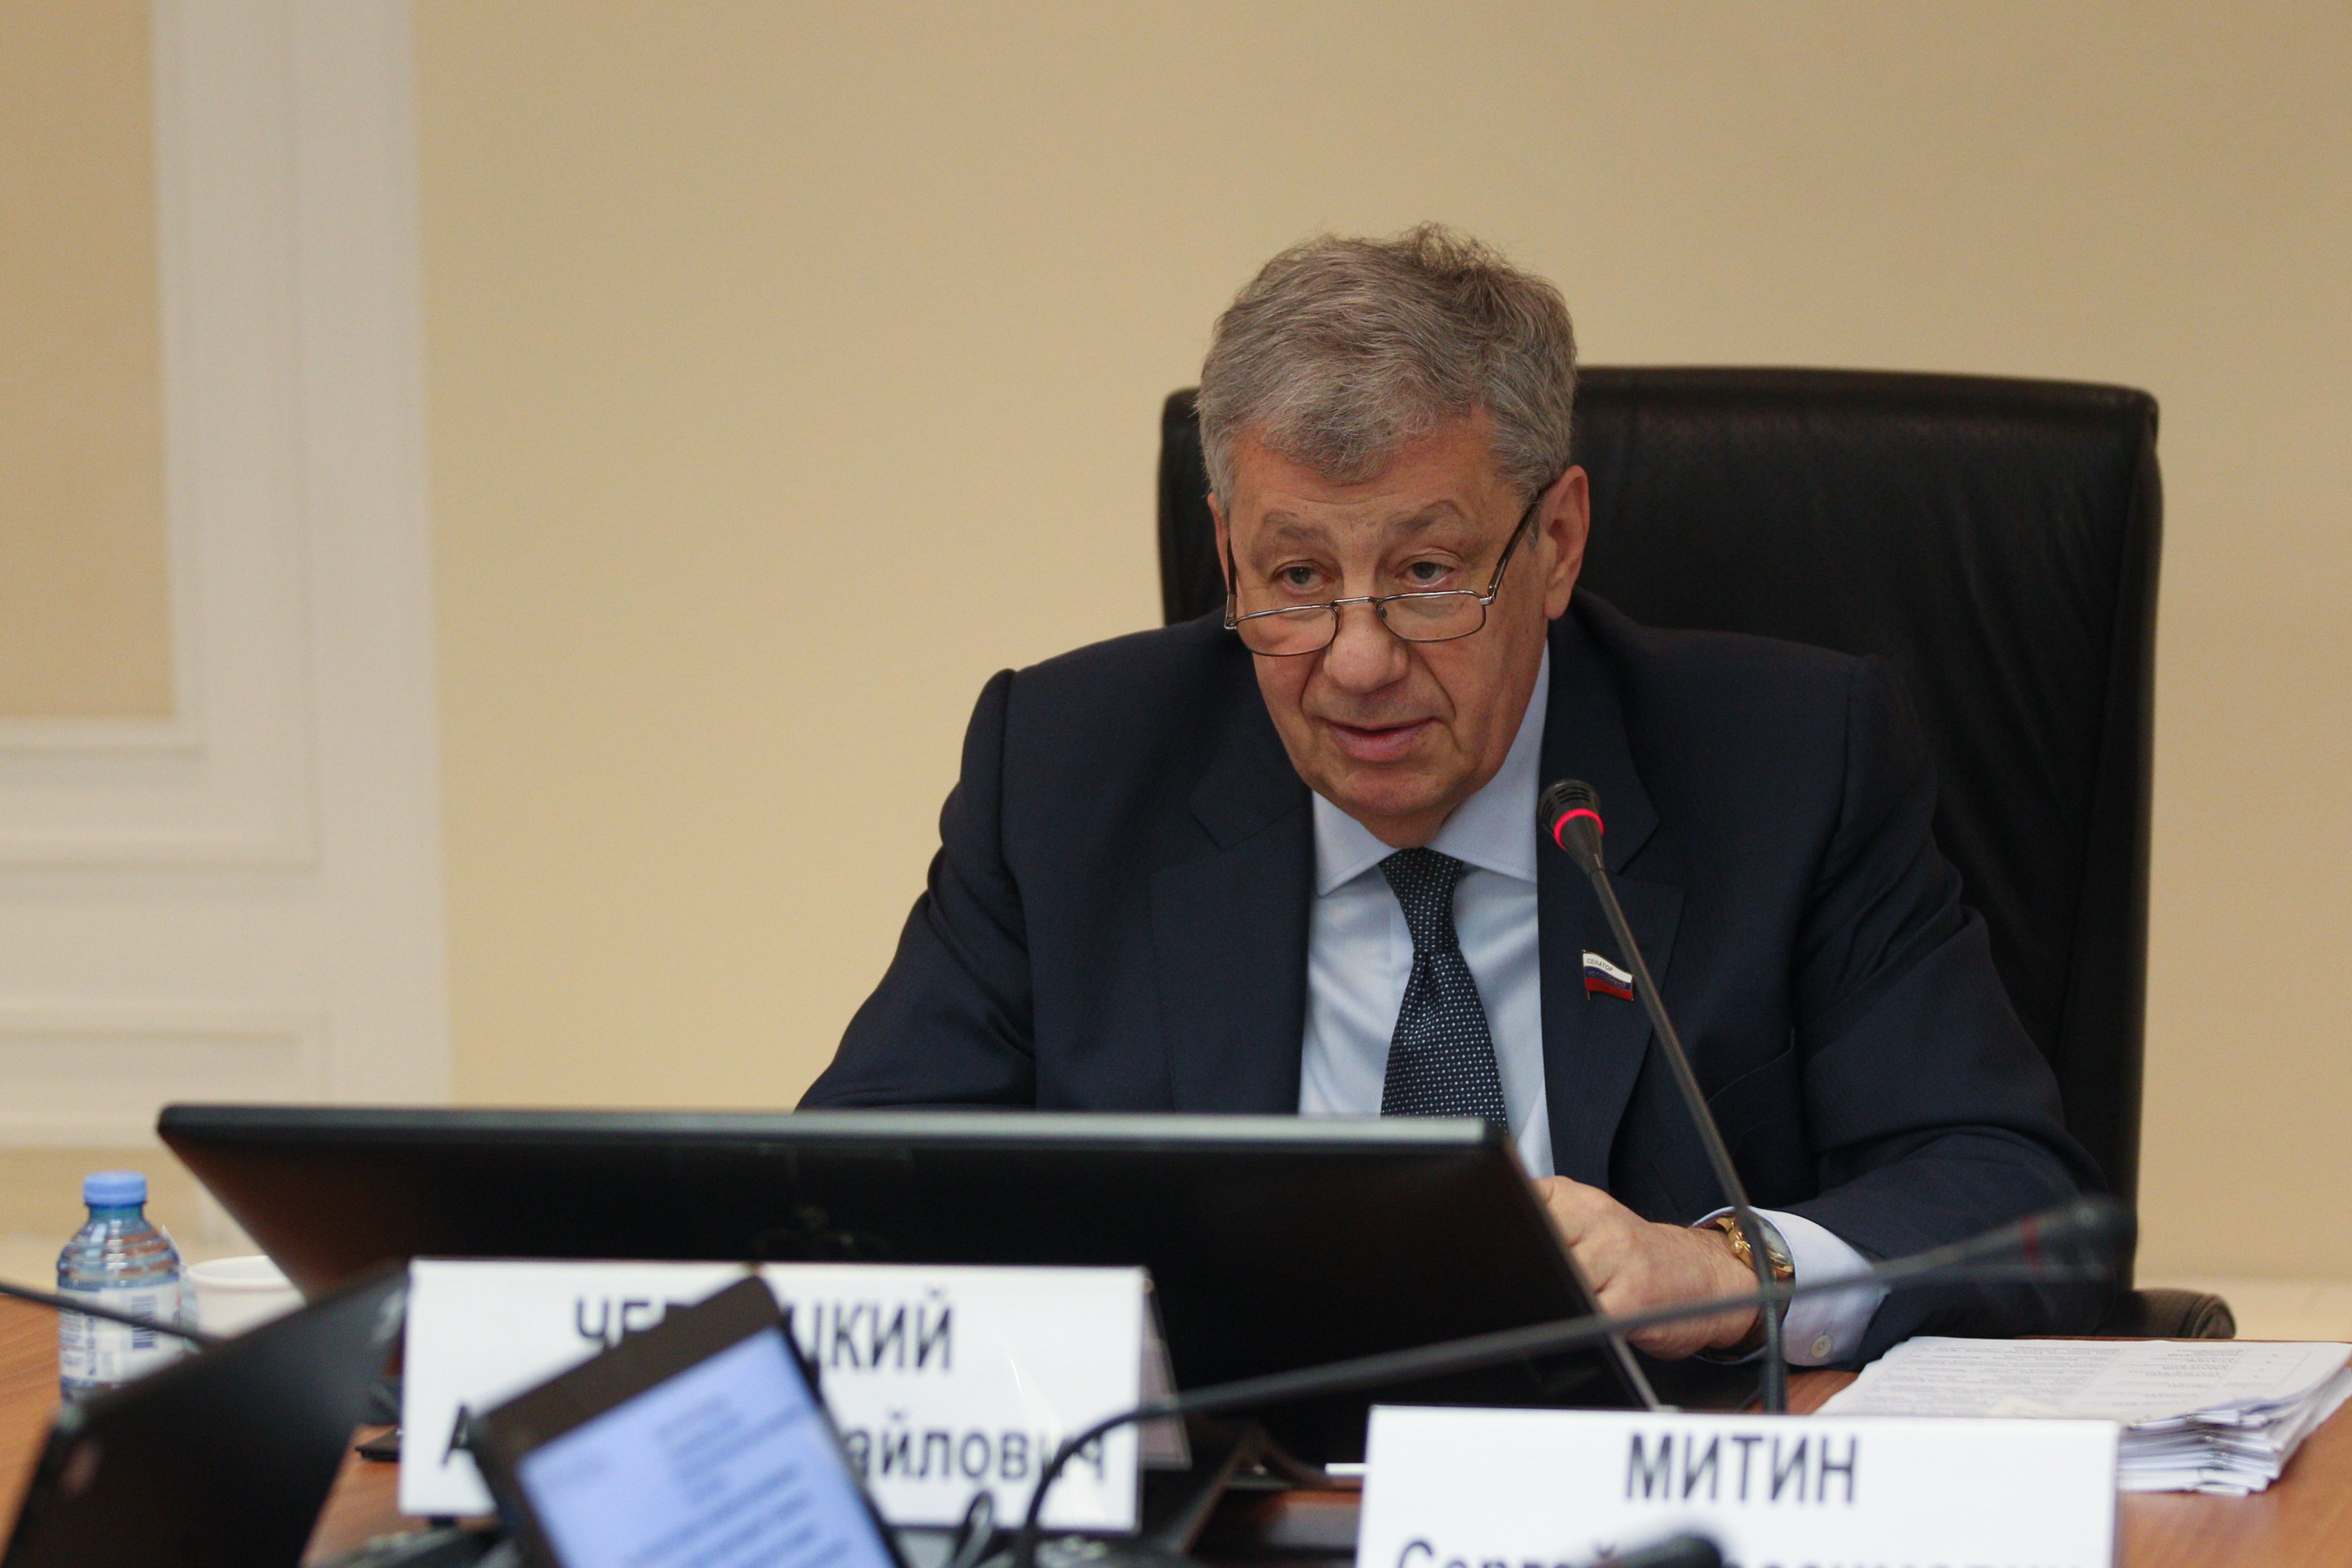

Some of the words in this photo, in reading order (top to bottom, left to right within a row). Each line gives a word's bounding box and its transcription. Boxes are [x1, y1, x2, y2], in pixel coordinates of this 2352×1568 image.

[1586, 958, 1613, 971] СЕНАТОР
[575, 1288, 953, 1369] ЧЕЦКИЙ
[1625, 1433, 1857, 1503] МИТИН
